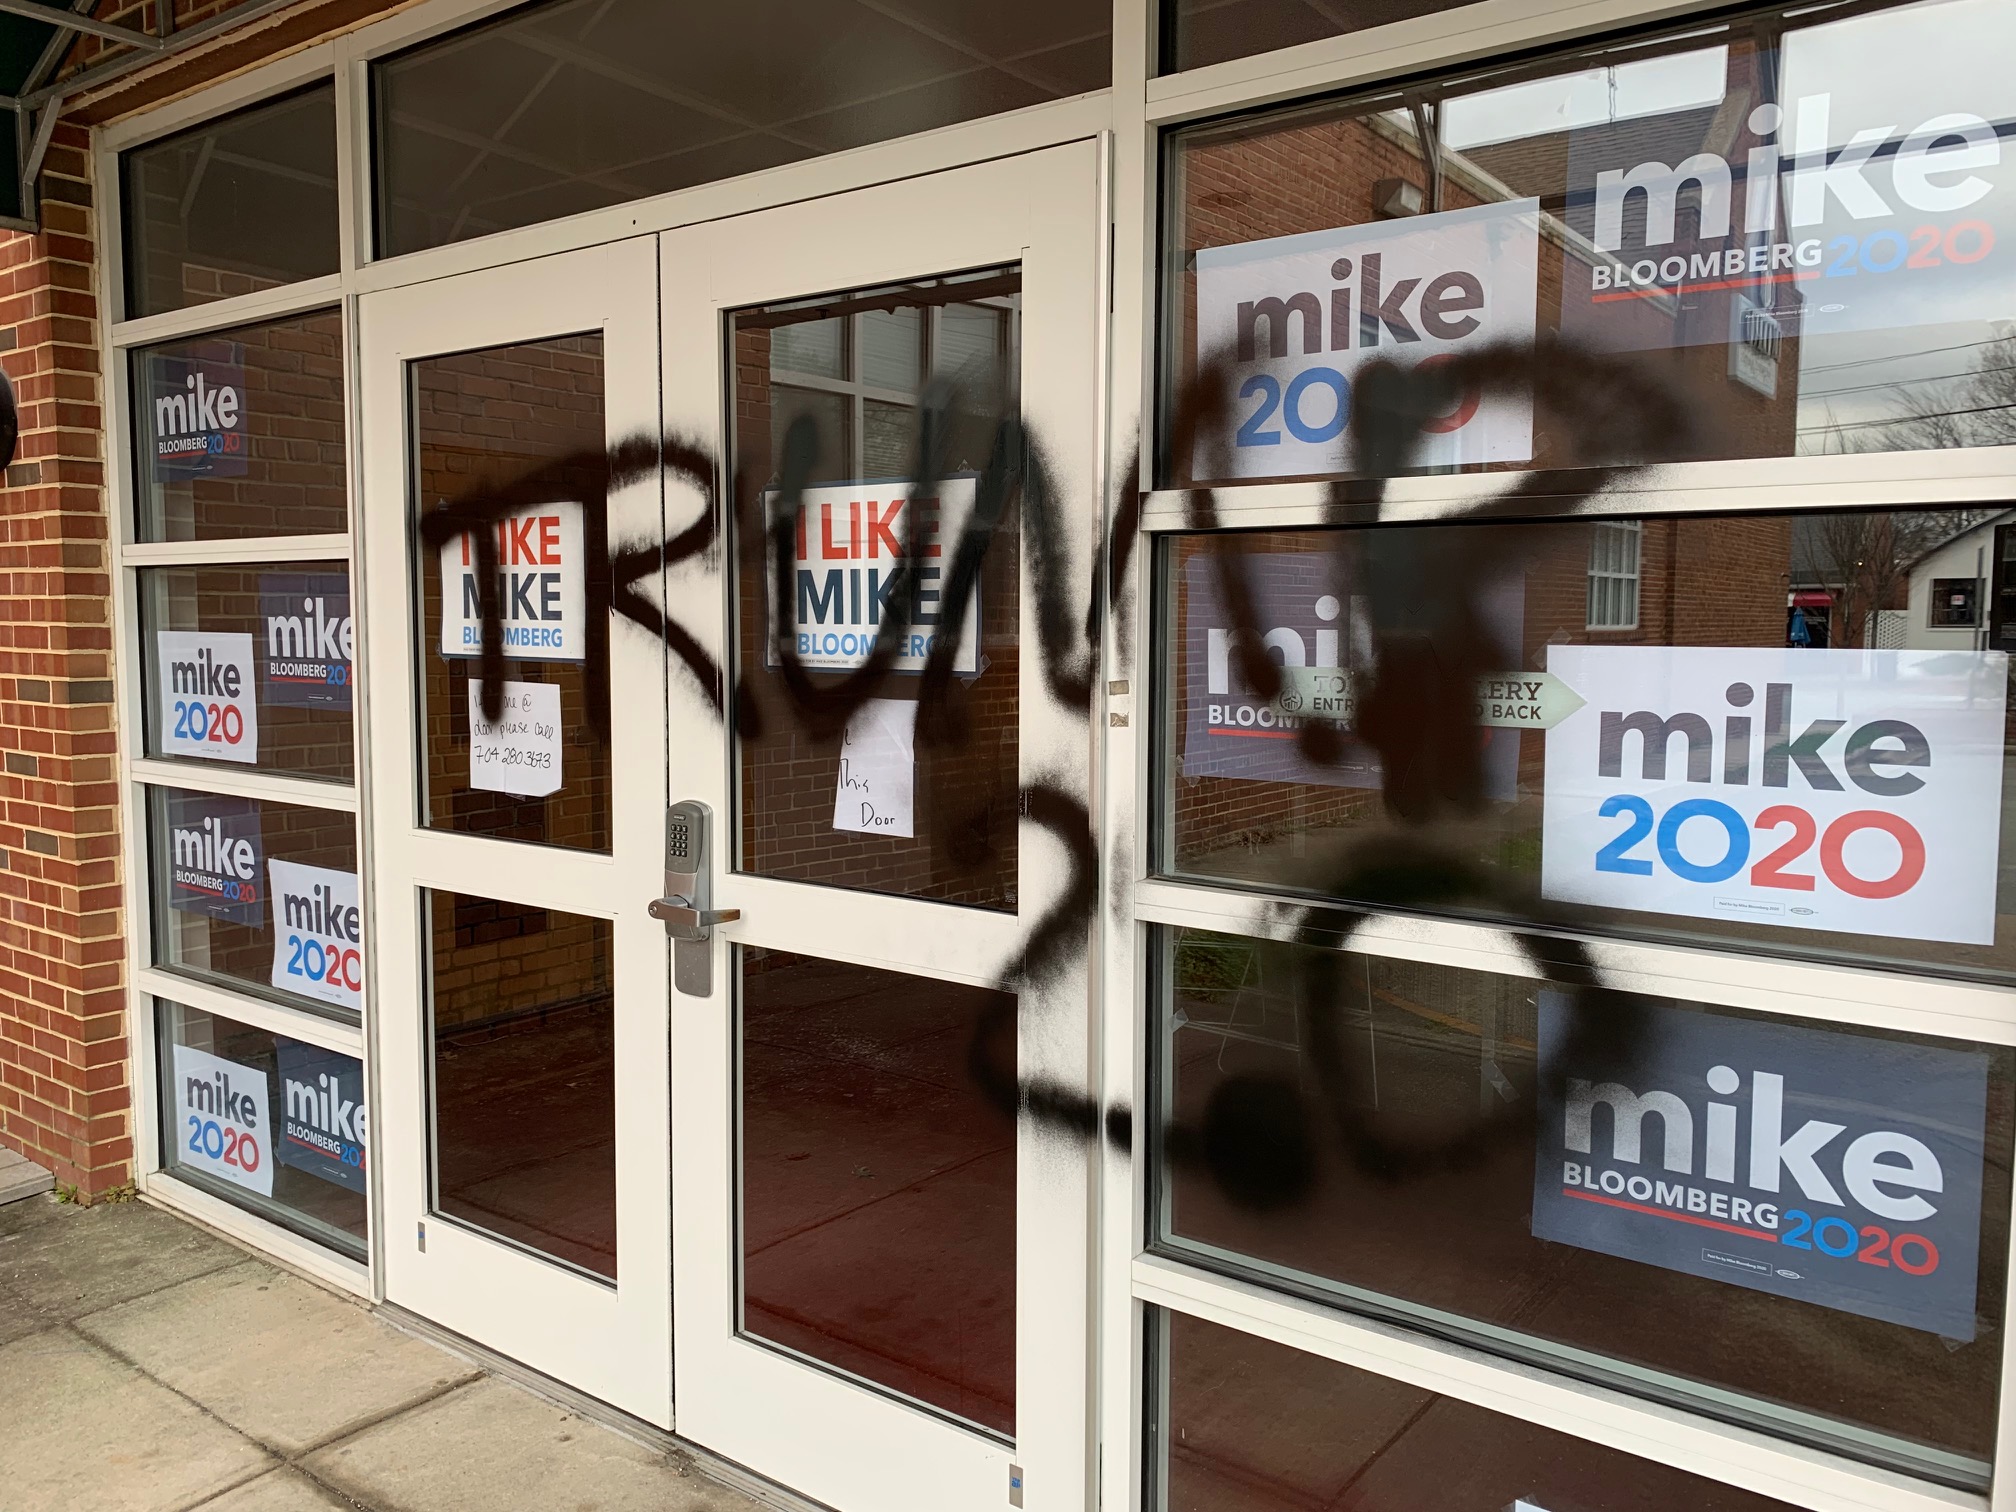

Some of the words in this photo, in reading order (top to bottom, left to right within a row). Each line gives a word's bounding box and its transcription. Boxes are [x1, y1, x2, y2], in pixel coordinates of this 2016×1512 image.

[1594, 92, 2002, 253] mike
[1591, 239, 1823, 290] BLOOMBERG
[1826, 220, 1995, 278] 2020
[1237, 252, 1485, 362] mike
[156, 372, 239, 437] mike
[1236, 354, 1482, 447] 200
[158, 436, 208, 454] BLOOMBERG
[207, 432, 240, 454] 2020
[497, 516, 562, 566] IKE
[820, 497, 942, 560] LIKE
[797, 566, 941, 626] MIKE
[268, 597, 352, 661] mike
[797, 633, 938, 658] BLOOMERG
[171, 647, 241, 698] mike
[270, 662, 327, 678] BLOOMBERG
[174, 700, 244, 745] 2020
[500, 721, 529, 739] please
[1492, 703, 1542, 720] BACK
[1598, 681, 1931, 796] mike
[861, 801, 896, 828] Door
[174, 816, 255, 880] mike
[1596, 794, 1927, 900] 2020
[176, 869, 223, 891] BLOOMBERG
[222, 881, 256, 904] 2020
[283, 883, 360, 944] mike
[287, 934, 362, 992] 2020
[187, 1071, 257, 1128] mike
[285, 1073, 367, 1147] mike
[188, 1115, 260, 1173] 2020
[287, 1121, 341, 1155] BLOOMBERG
[1562, 1065, 1944, 1222] mike
[1561, 1160, 1780, 1230] BLOOMBERG
[1781, 1208, 1941, 1277] 2020
